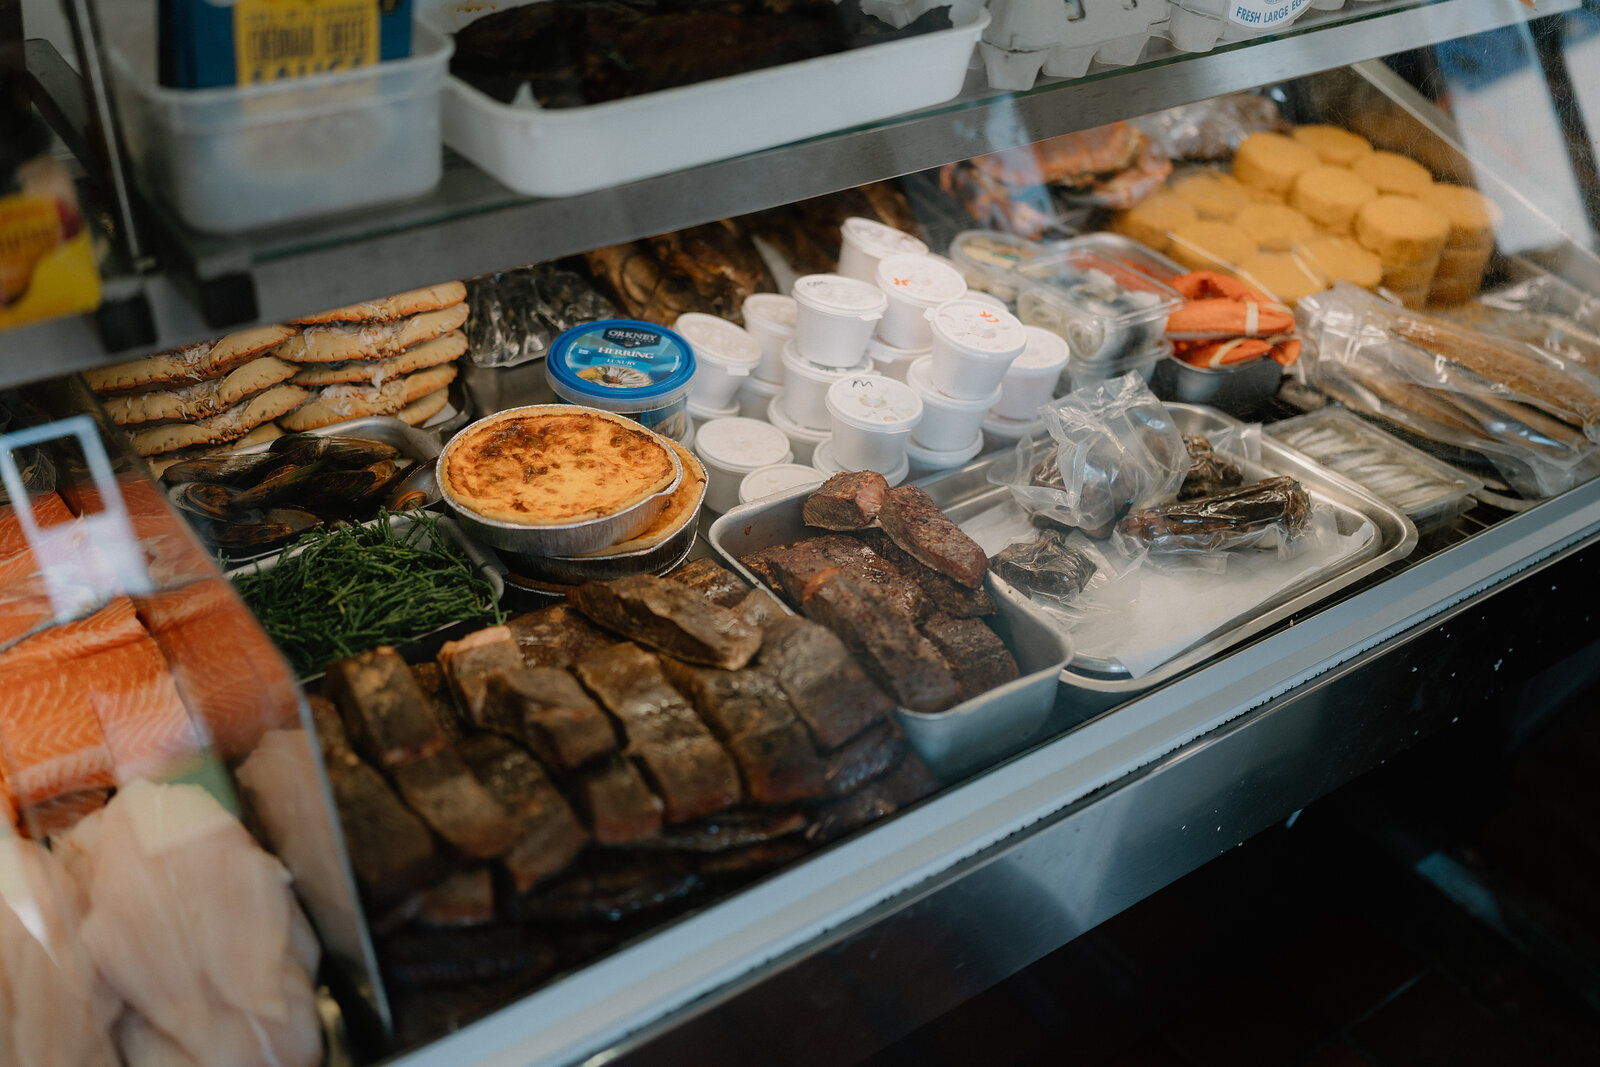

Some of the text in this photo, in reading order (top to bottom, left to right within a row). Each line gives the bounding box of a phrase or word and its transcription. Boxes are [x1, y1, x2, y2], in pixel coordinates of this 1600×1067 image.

[1236, 0, 1307, 23] FRESH LARGE EG
[608, 330, 657, 341] ORKNEY
[598, 346, 654, 359] HERRING
[607, 358, 636, 366] LUXURY
